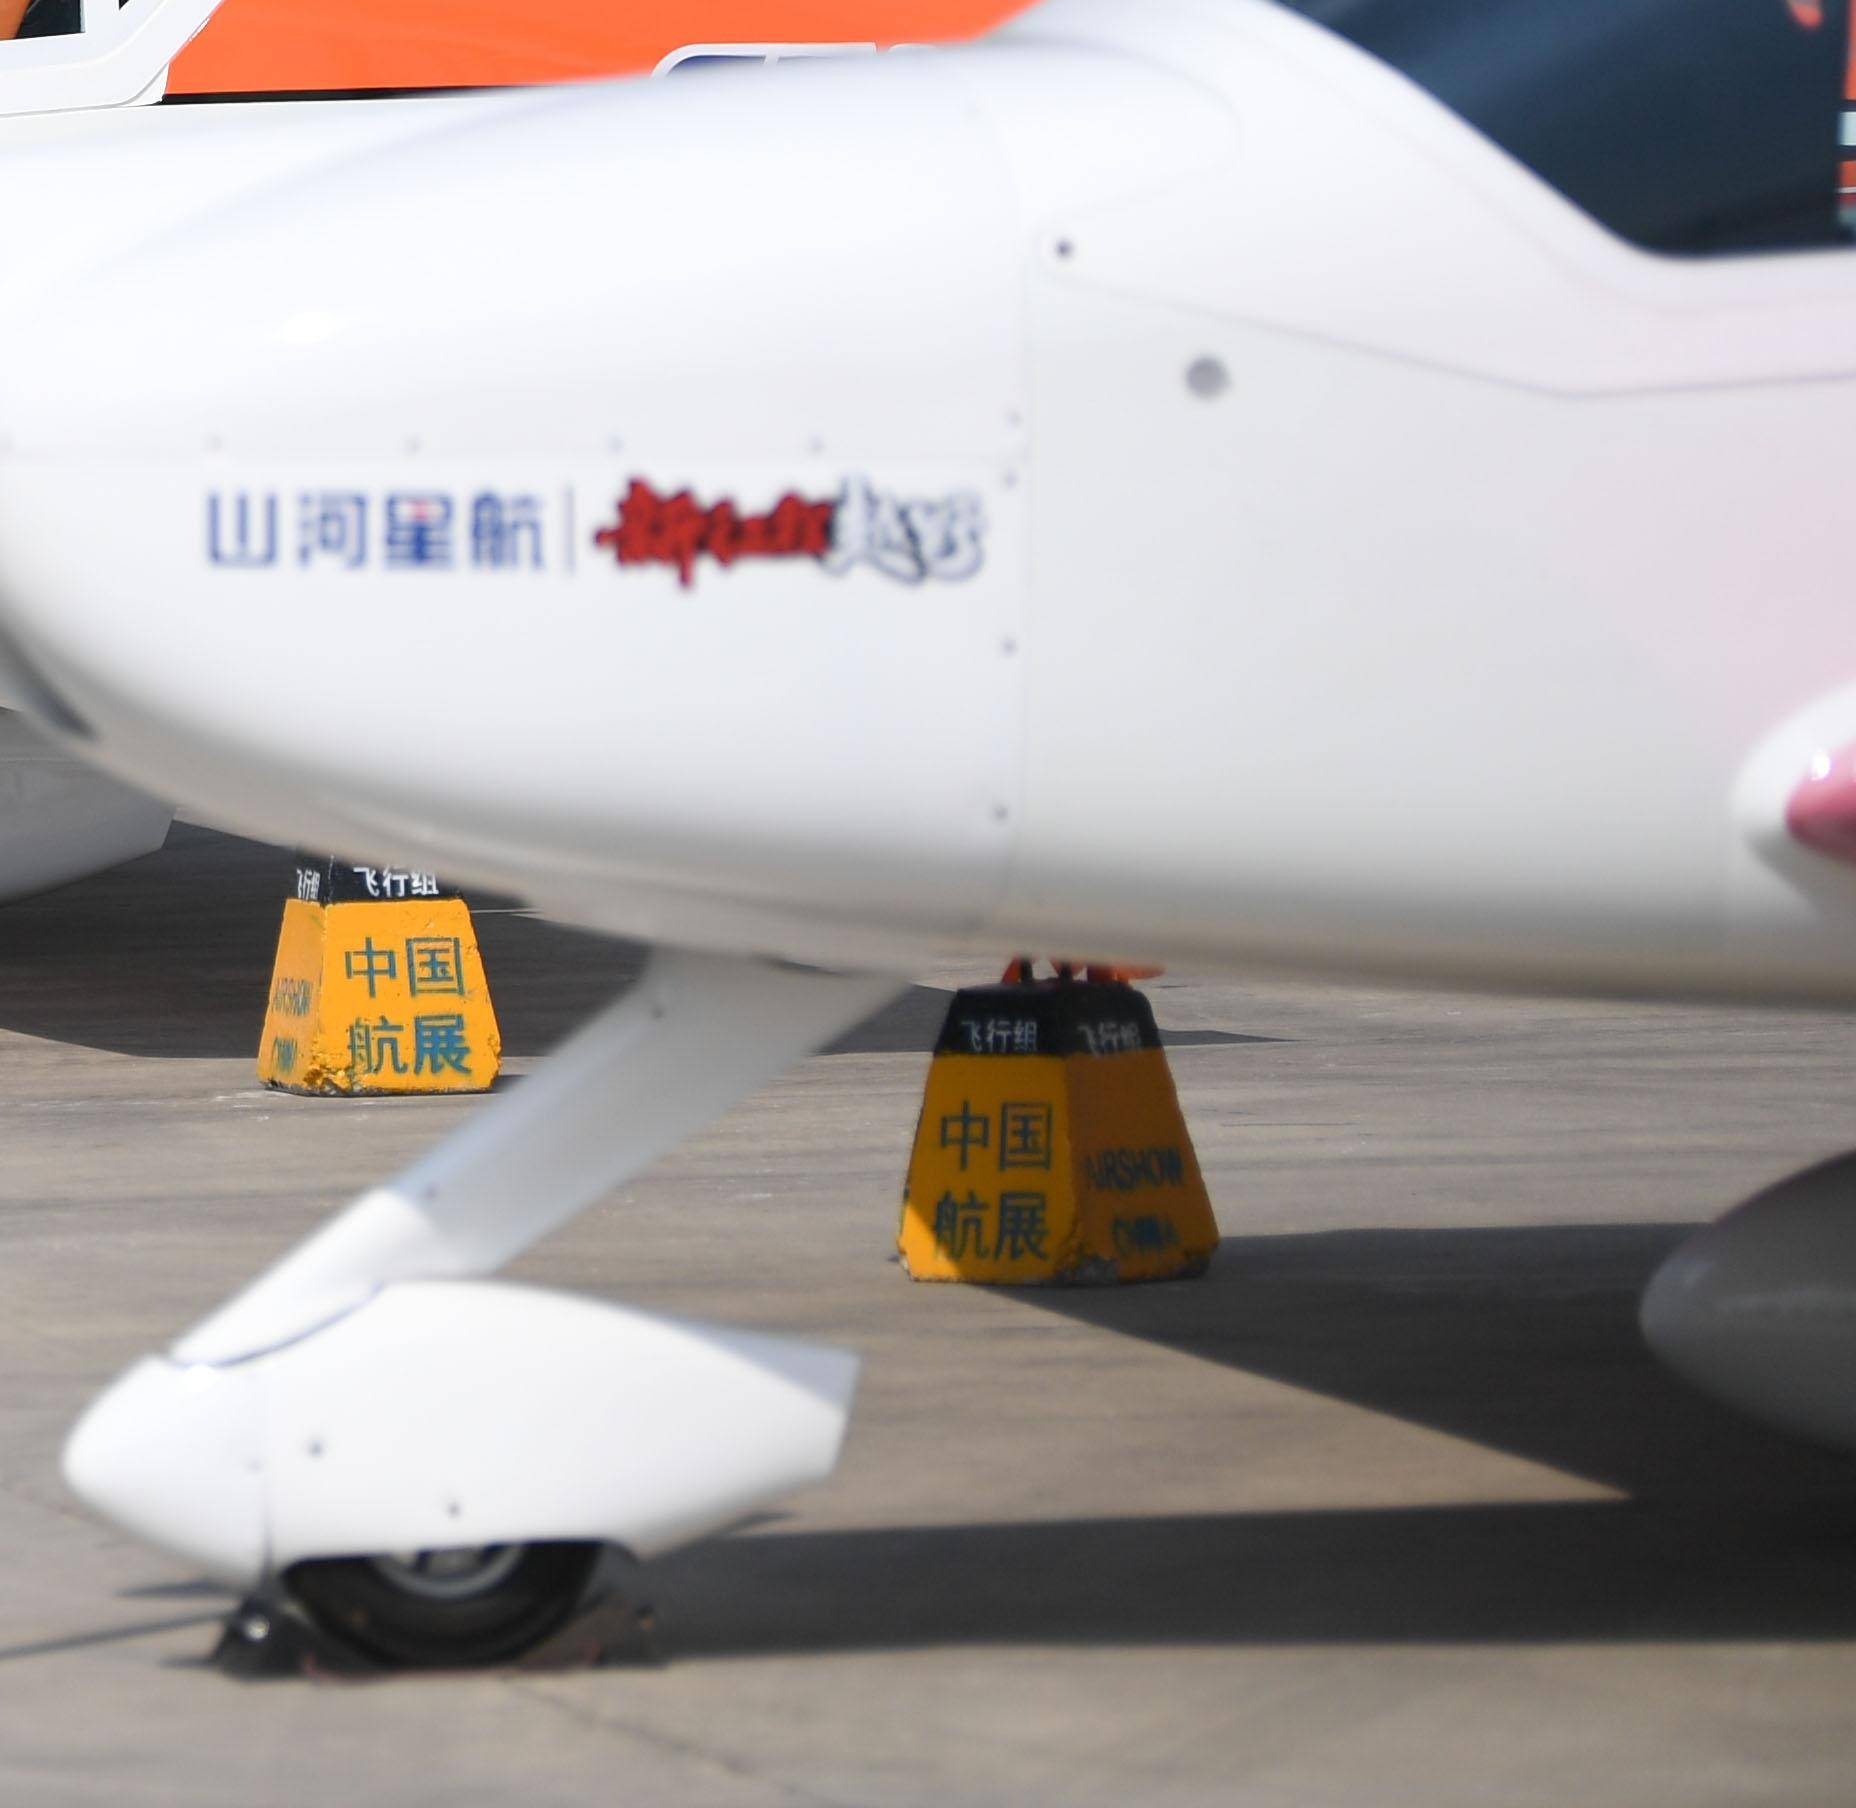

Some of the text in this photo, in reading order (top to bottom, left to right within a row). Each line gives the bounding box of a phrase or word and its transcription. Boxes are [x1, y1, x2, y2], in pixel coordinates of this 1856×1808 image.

[205, 488, 544, 570] 山河星航
[353, 865, 439, 896] 飞行组
[344, 936, 466, 998] 中国
[346, 1014, 472, 1075] 航展
[961, 1019, 1038, 1052] 飞行组
[939, 1098, 1053, 1173] 中国
[933, 1189, 1052, 1262] 航展
